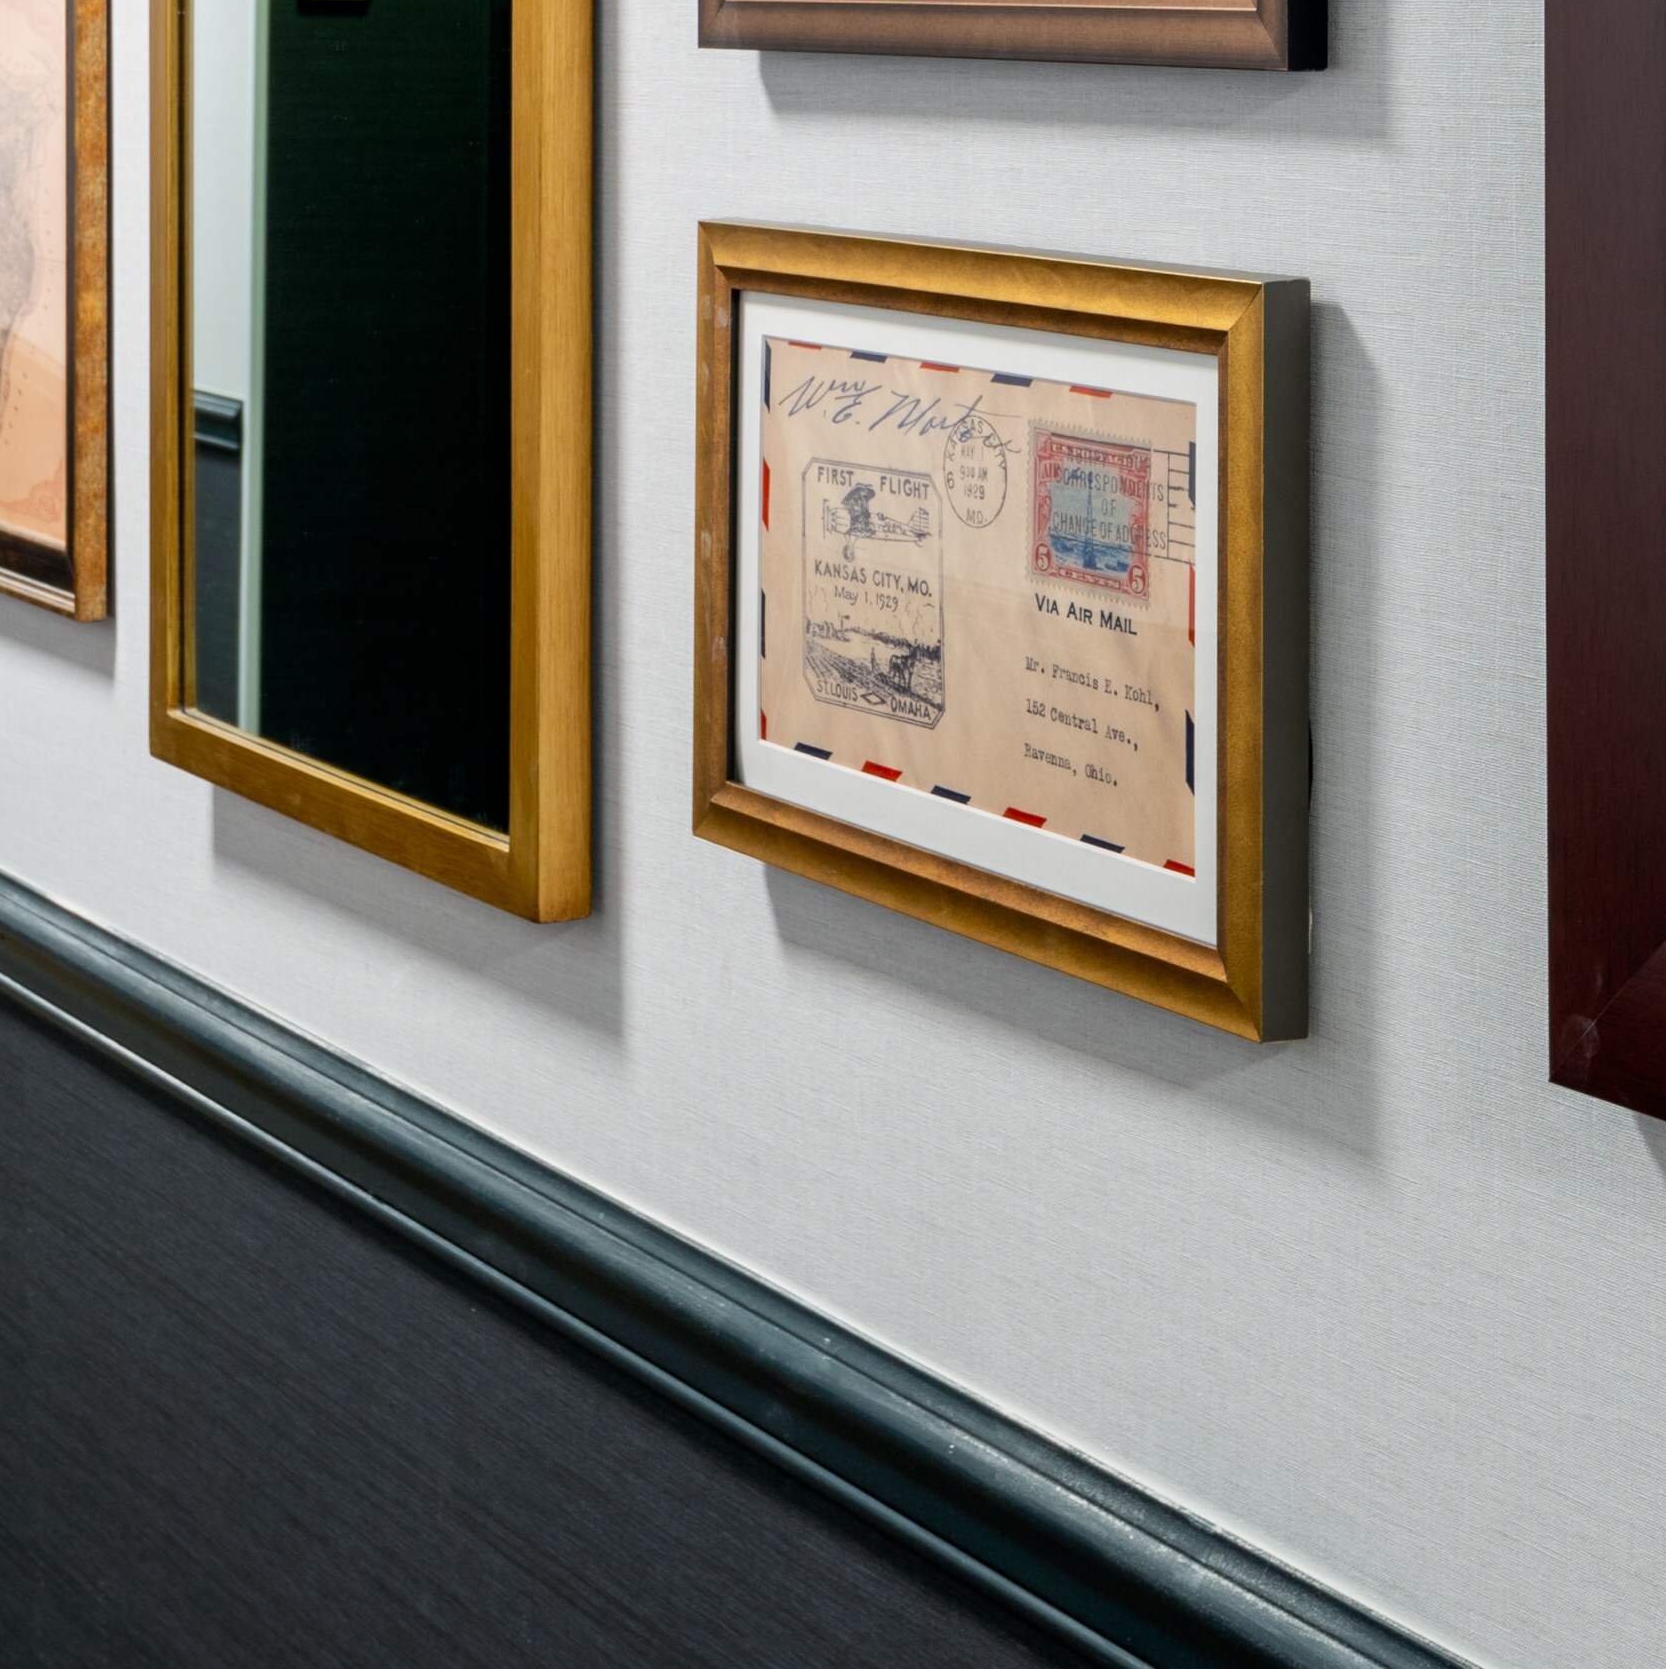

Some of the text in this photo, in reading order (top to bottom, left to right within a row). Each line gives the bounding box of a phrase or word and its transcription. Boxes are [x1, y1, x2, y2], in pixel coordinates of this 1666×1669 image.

[817, 466, 930, 500] FIRST FLIGHT
[946, 471, 955, 490] 6
[1101, 498, 1117, 518] OF
[1037, 545, 1050, 571] 5
[814, 559, 867, 584] KANSAS
[908, 577, 933, 598] MO.
[1130, 567, 1146, 594] 5
[834, 585, 859, 607] May
[1035, 593, 1138, 636] VIA AIR MAIL
[1025, 656, 1160, 712] Mr. Francis E. Kohl,
[890, 696, 932, 721] OMAHA
[1026, 698, 1046, 717] 152
[1050, 707, 1099, 734] Central
[1024, 742, 1077, 777] Ravenna,
